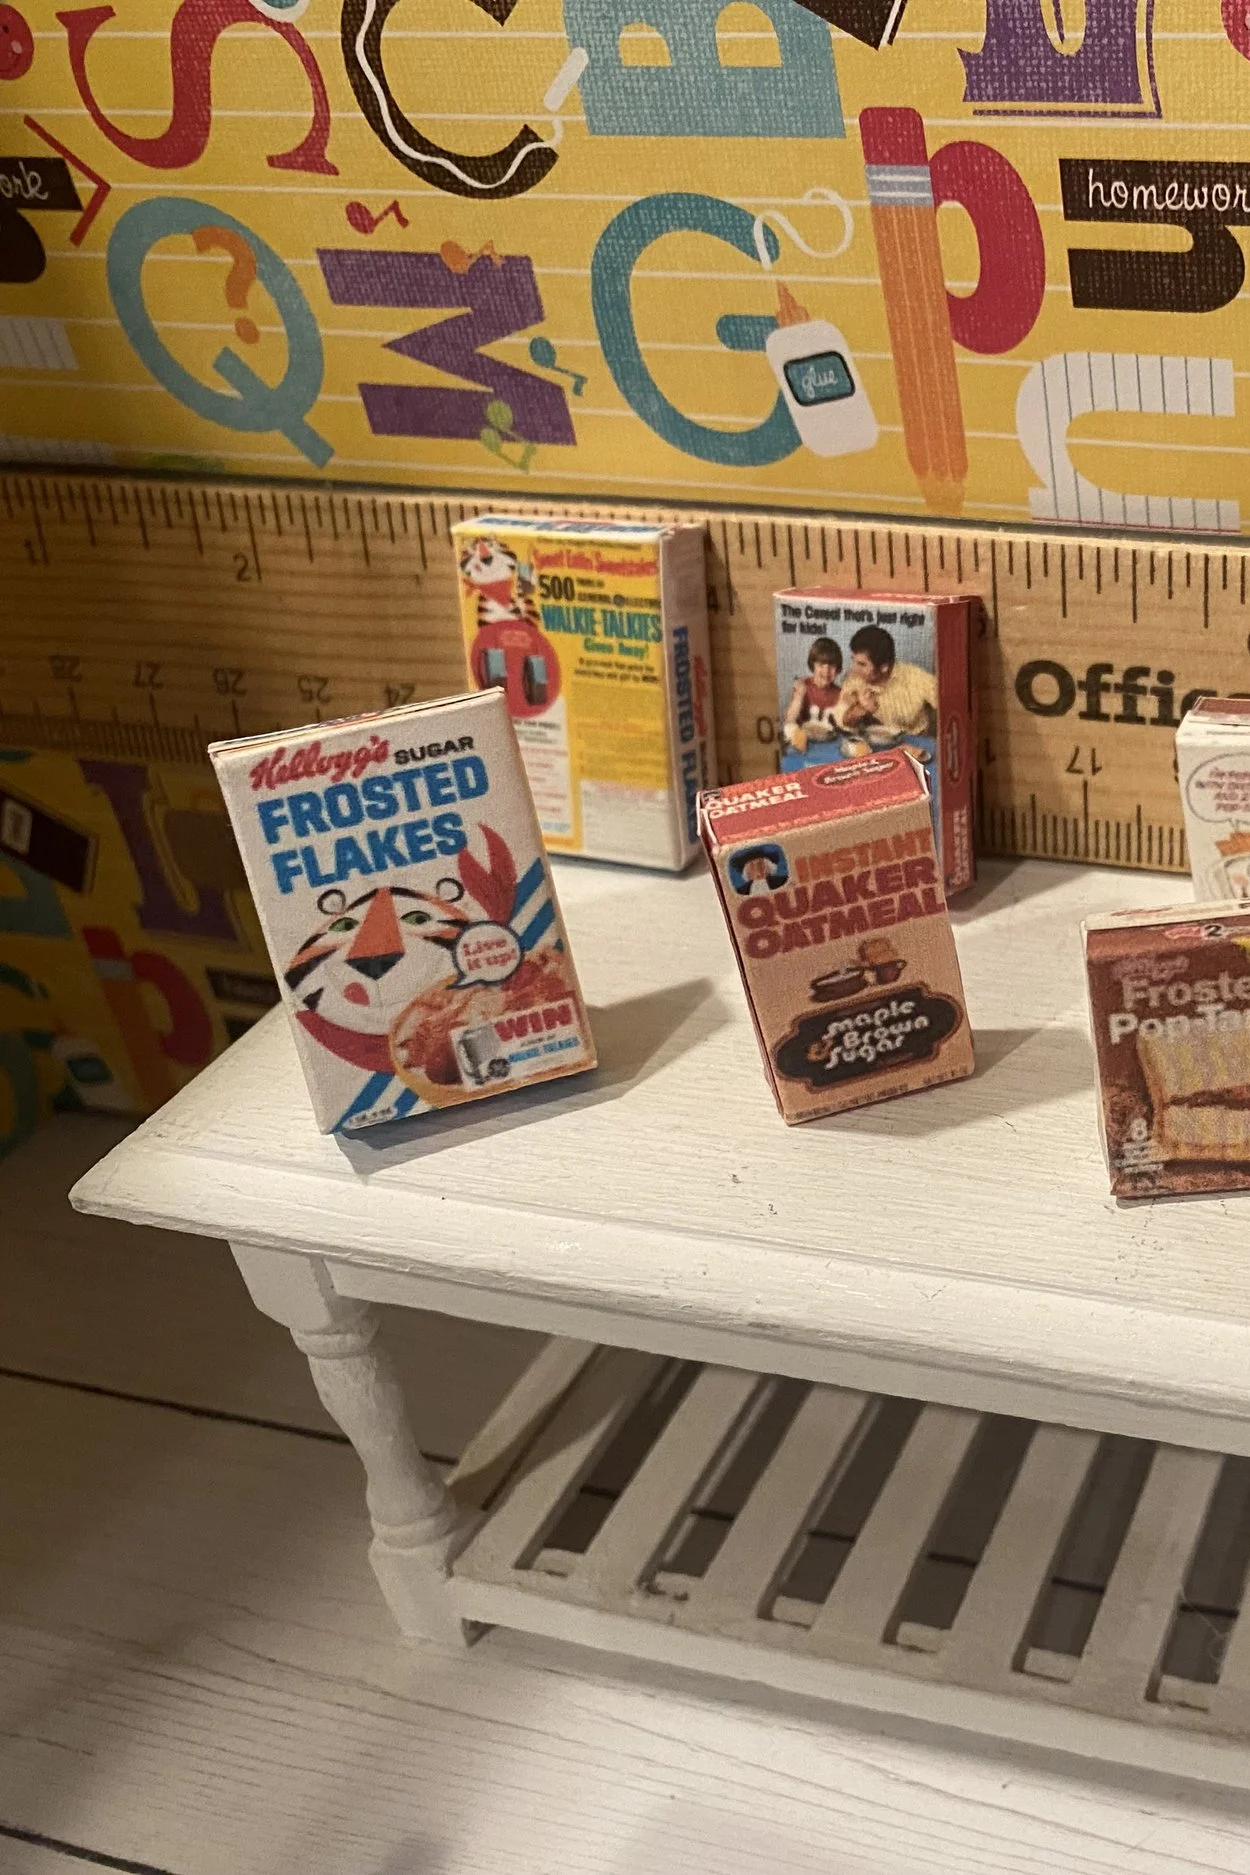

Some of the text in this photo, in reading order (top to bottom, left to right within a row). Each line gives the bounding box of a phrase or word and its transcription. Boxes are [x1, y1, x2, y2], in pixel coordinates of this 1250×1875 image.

[802, 366, 838, 399] glue
[234, 555, 250, 582] 2
[539, 574, 575, 601] 500
[601, 609, 663, 642] TALKIES
[781, 604, 801, 618] The
[673, 626, 694, 744] FROSTED
[249, 735, 475, 791] Kellogg's SUGAR
[257, 755, 489, 845] FROSTED
[705, 782, 800, 810] QUAKER
[710, 791, 809, 819] OATMEAL
[271, 812, 468, 895] FLAKES
[794, 827, 932, 885] INSTANT
[737, 856, 938, 929] QUAKER
[744, 887, 946, 959] OATMEAL
[494, 1004, 573, 1042] WIN
